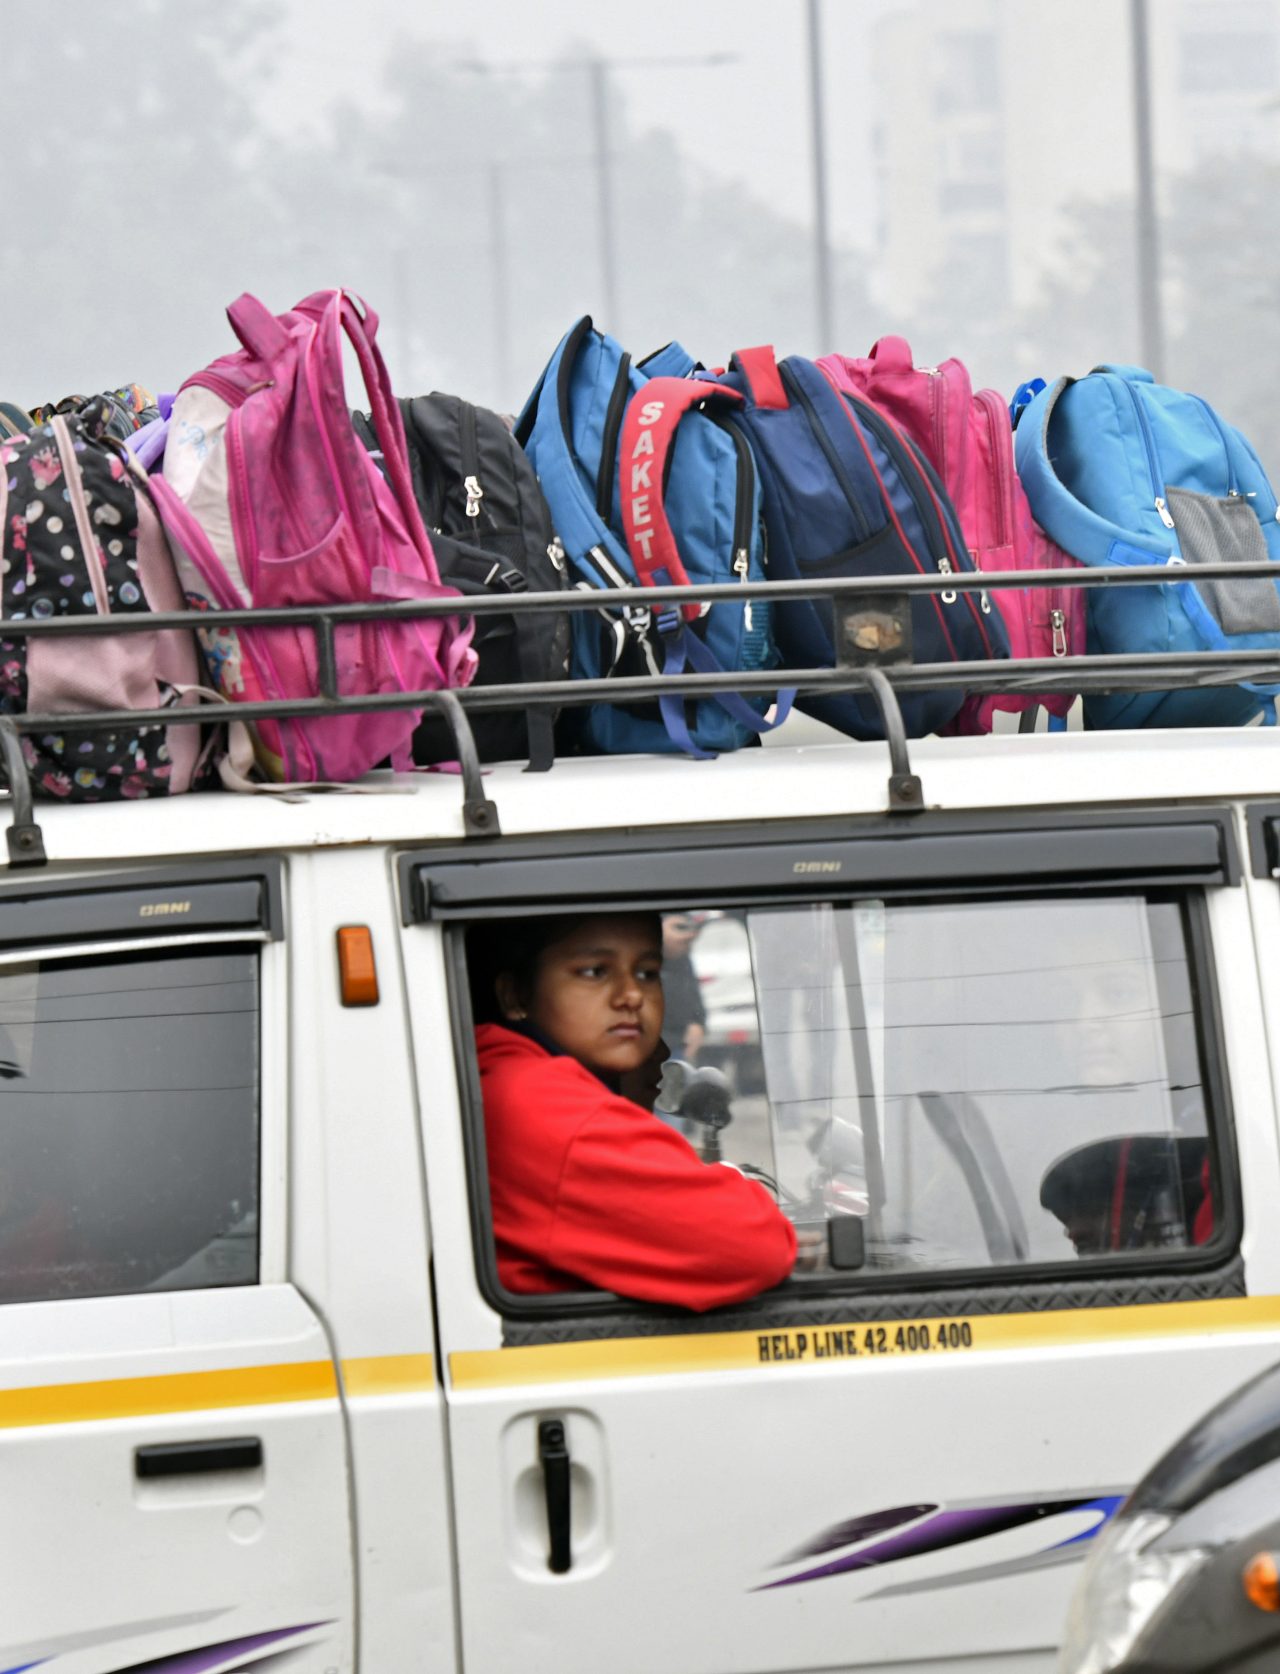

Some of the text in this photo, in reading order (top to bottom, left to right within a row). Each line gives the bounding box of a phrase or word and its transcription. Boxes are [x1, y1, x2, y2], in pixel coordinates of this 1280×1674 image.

[631, 401, 665, 560] SAKET
[792, 862, 842, 873] OMNI
[140, 901, 192, 916] OMNI
[758, 1333, 807, 1361] HELP
